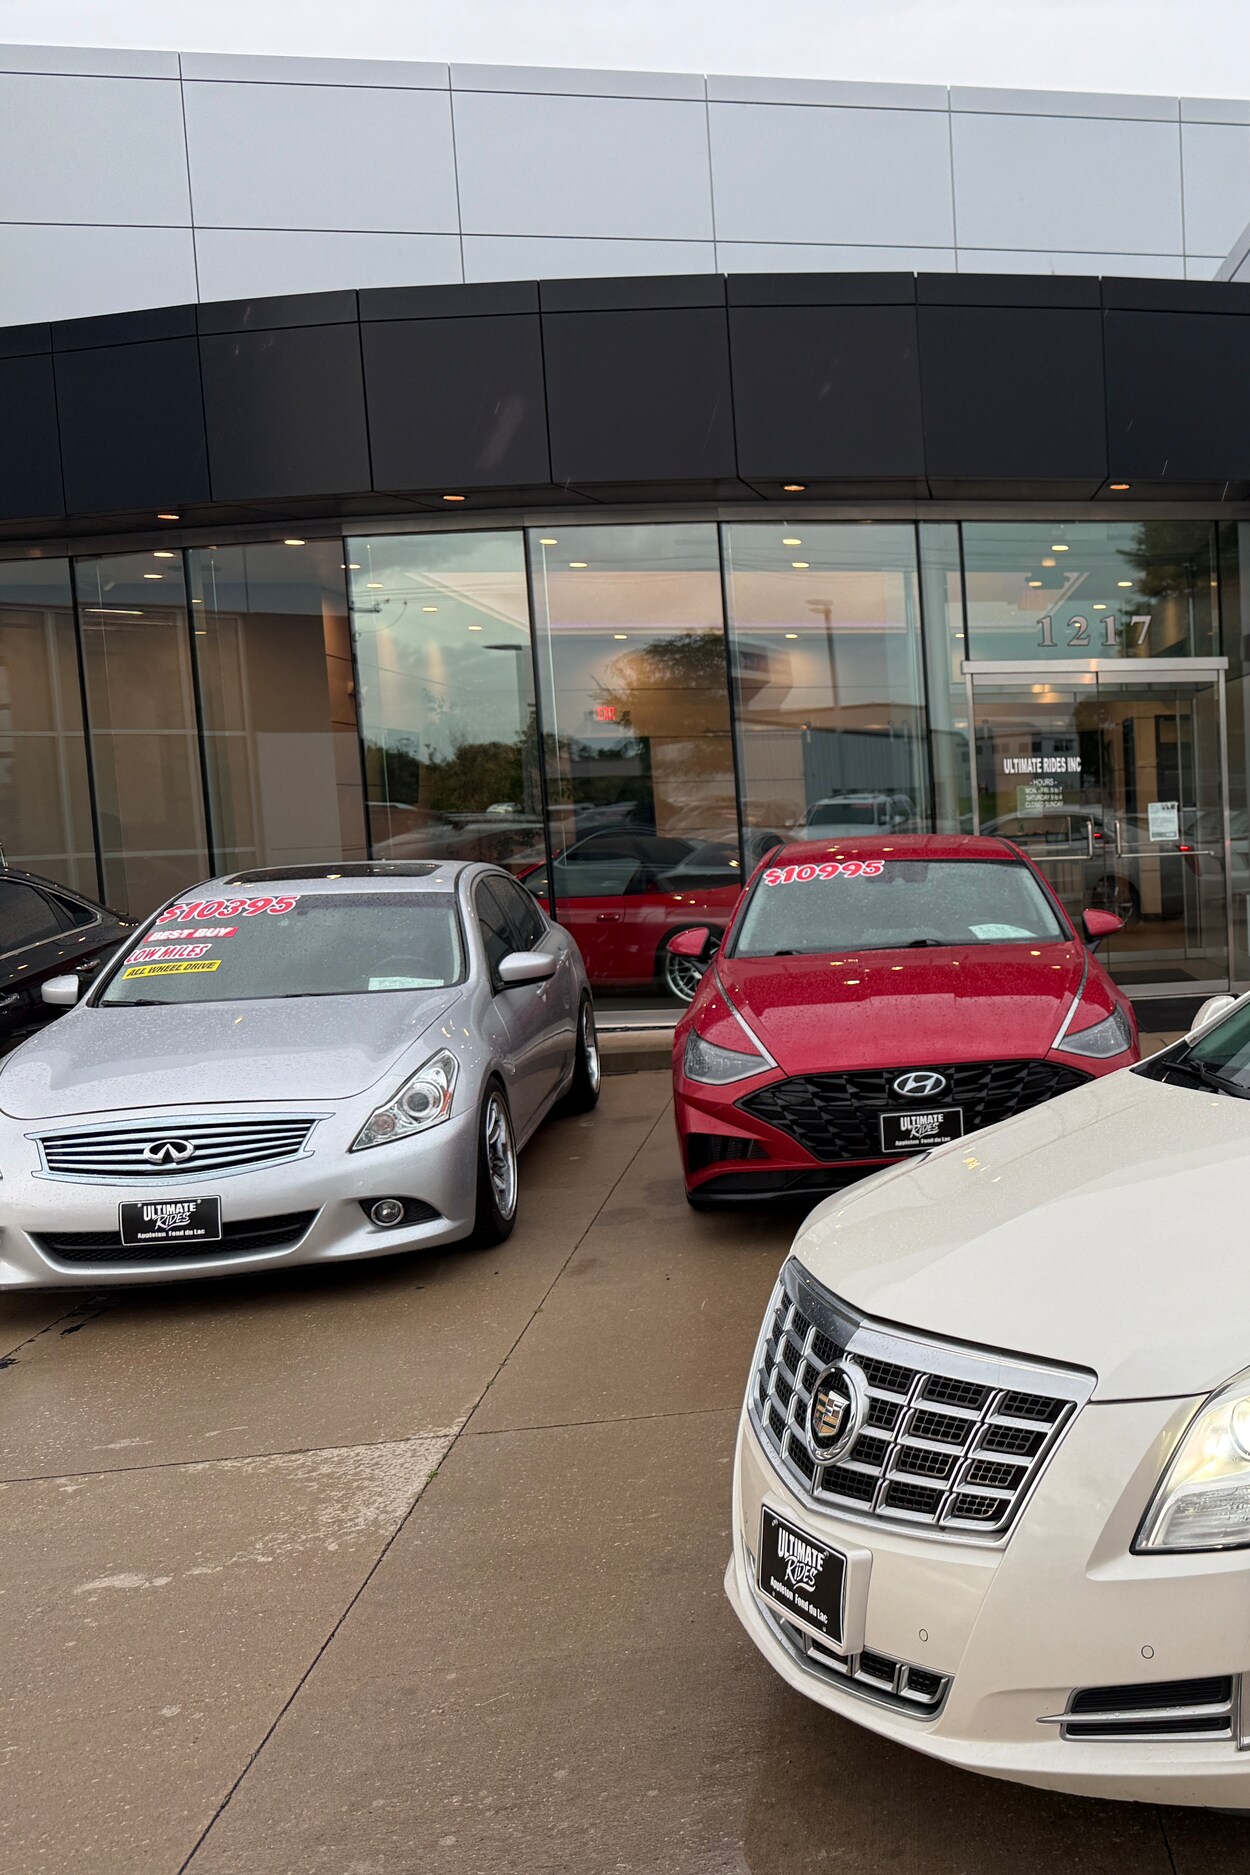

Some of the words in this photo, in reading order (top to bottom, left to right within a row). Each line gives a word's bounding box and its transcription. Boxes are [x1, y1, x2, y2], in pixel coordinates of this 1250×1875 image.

[1036, 614, 1152, 647] 1217
[597, 706, 617, 721] EXIT
[1003, 758, 1043, 774] ULTIMATE
[1043, 757, 1067, 773] RIDES
[1067, 756, 1082, 772] INC
[1033, 778, 1054, 786] HOURS
[762, 860, 885, 887] $10995
[156, 896, 301, 925] $10395
[149, 929, 192, 942] BEST
[192, 927, 232, 938] BUY
[124, 946, 160, 965] LOW
[158, 944, 212, 961] MILES
[126, 967, 147, 977] ALL
[148, 964, 182, 974] WHEEL
[183, 961, 217, 971] DRIVE
[900, 1113, 944, 1131] ULTIMATE
[143, 1202, 197, 1221] ULTIMATE
[137, 1231, 167, 1239] Appleton
[777, 1527, 825, 1572] ULTIMATE
[770, 1575, 794, 1601] Appleton
[794, 1593, 809, 1612] Fond
[809, 1603, 817, 1617] du
[817, 1608, 828, 1624] Lac
